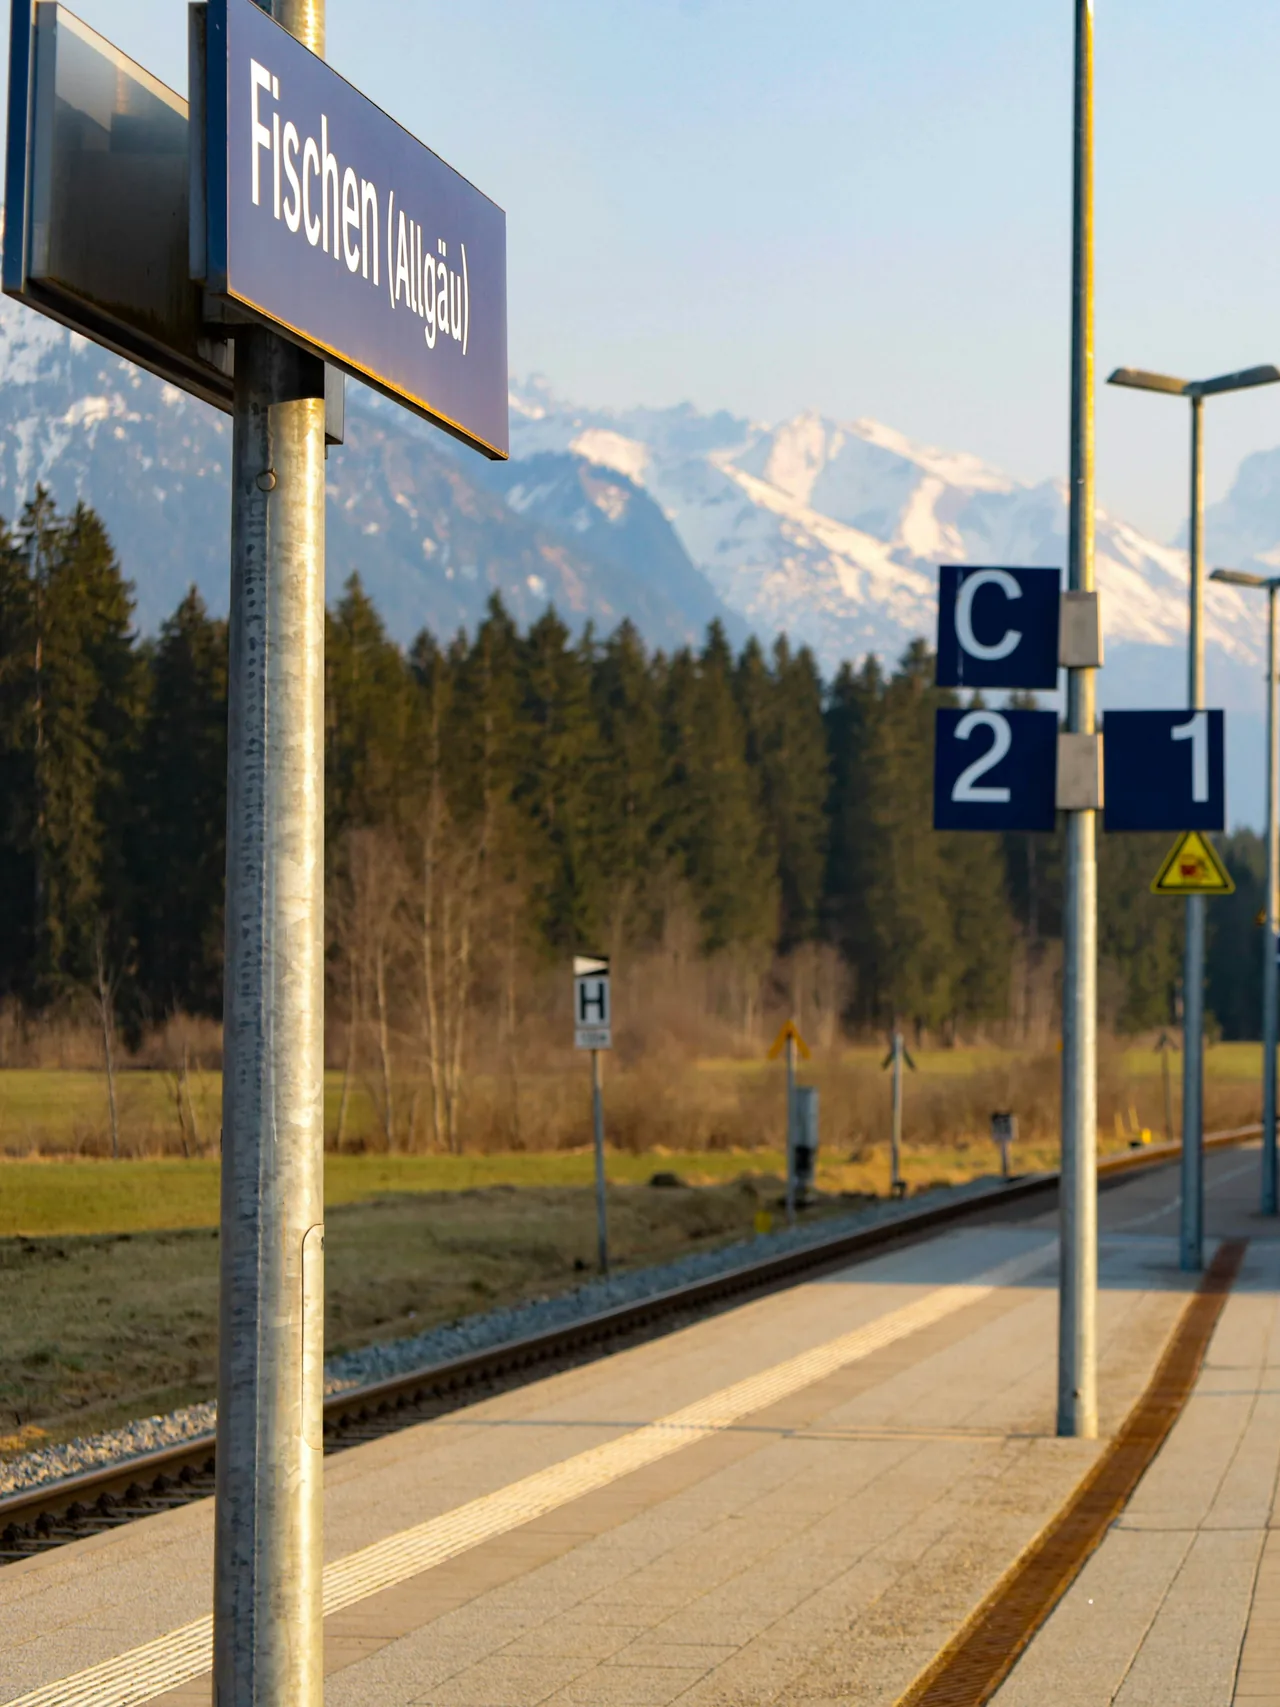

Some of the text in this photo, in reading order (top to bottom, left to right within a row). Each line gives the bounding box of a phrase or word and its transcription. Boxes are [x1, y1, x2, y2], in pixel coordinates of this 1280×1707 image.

[250, 58, 470, 356] Fischen (Allgäu)
[954, 569, 1023, 661] C
[951, 711, 1012, 803] 2
[1170, 712, 1210, 803] 1
[580, 983, 604, 1020] H
